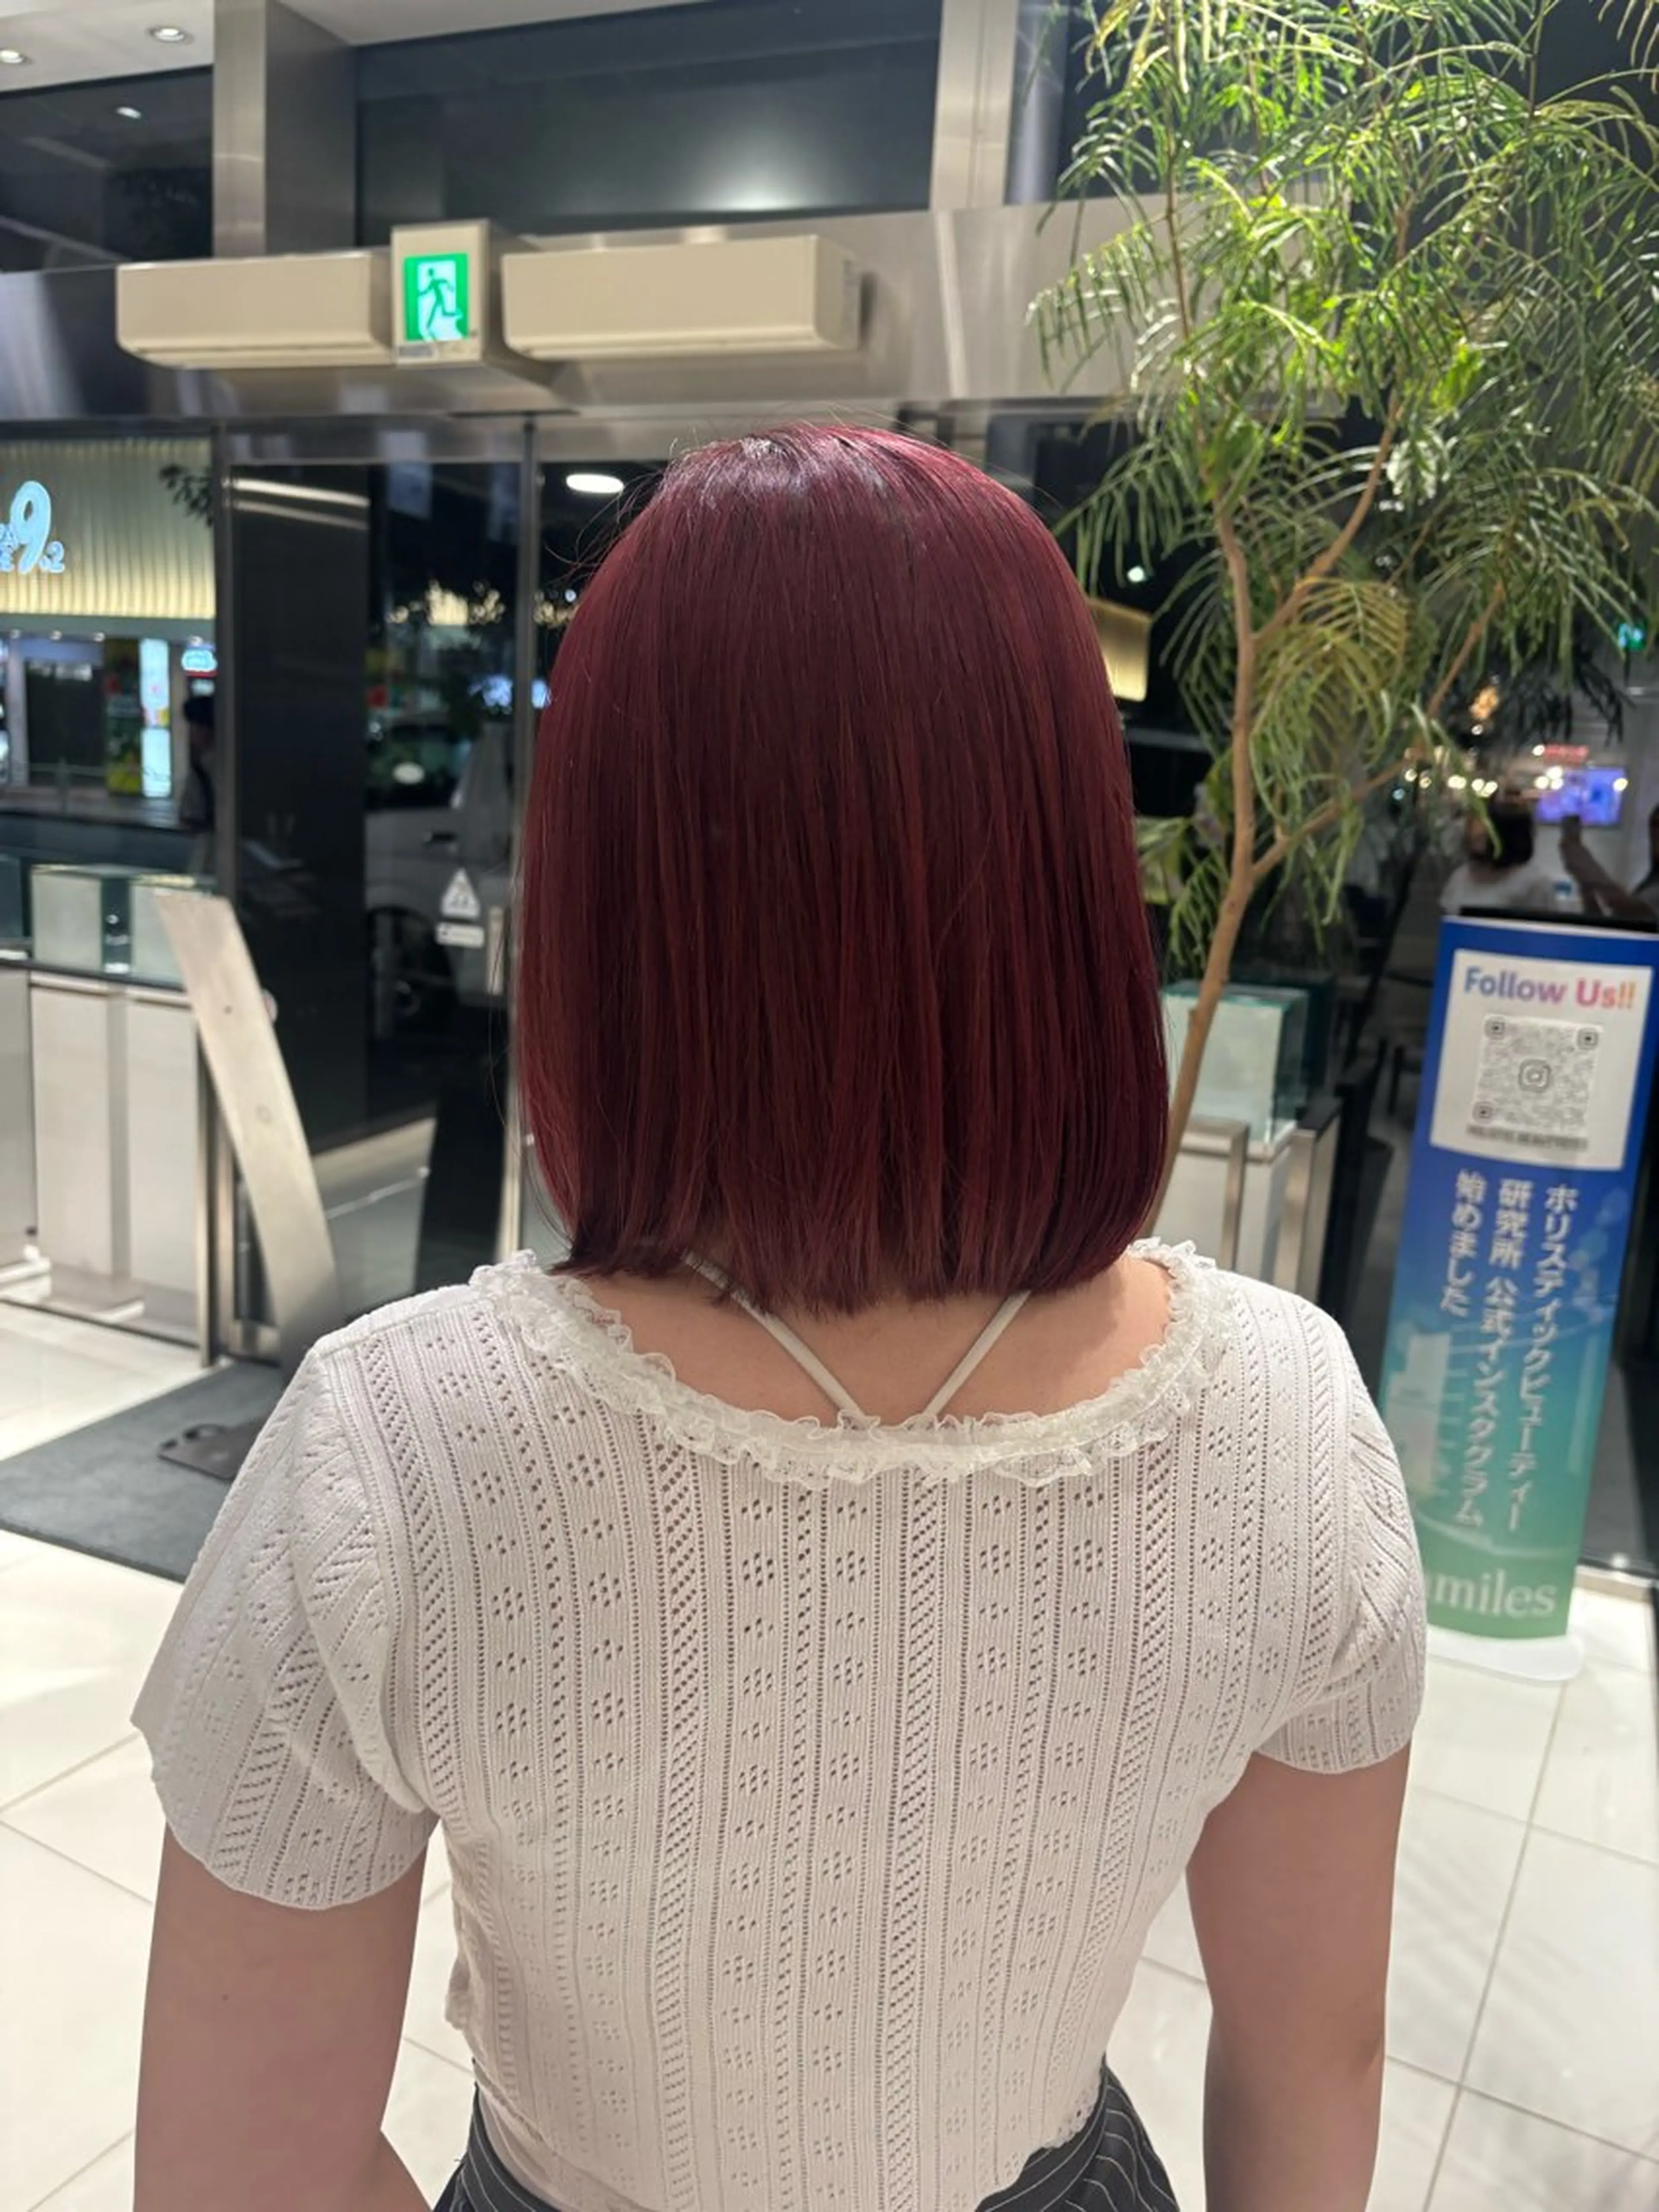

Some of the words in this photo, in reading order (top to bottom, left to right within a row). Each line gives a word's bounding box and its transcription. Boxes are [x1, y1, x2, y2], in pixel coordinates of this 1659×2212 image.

[1464, 966, 1568, 1005] Follow
[1574, 977, 1637, 1010] Us!!
[1440, 1167, 1488, 1317] 始めました
[1488, 1177, 1535, 1270] 研究所
[1424, 1567, 1559, 1619] miles
